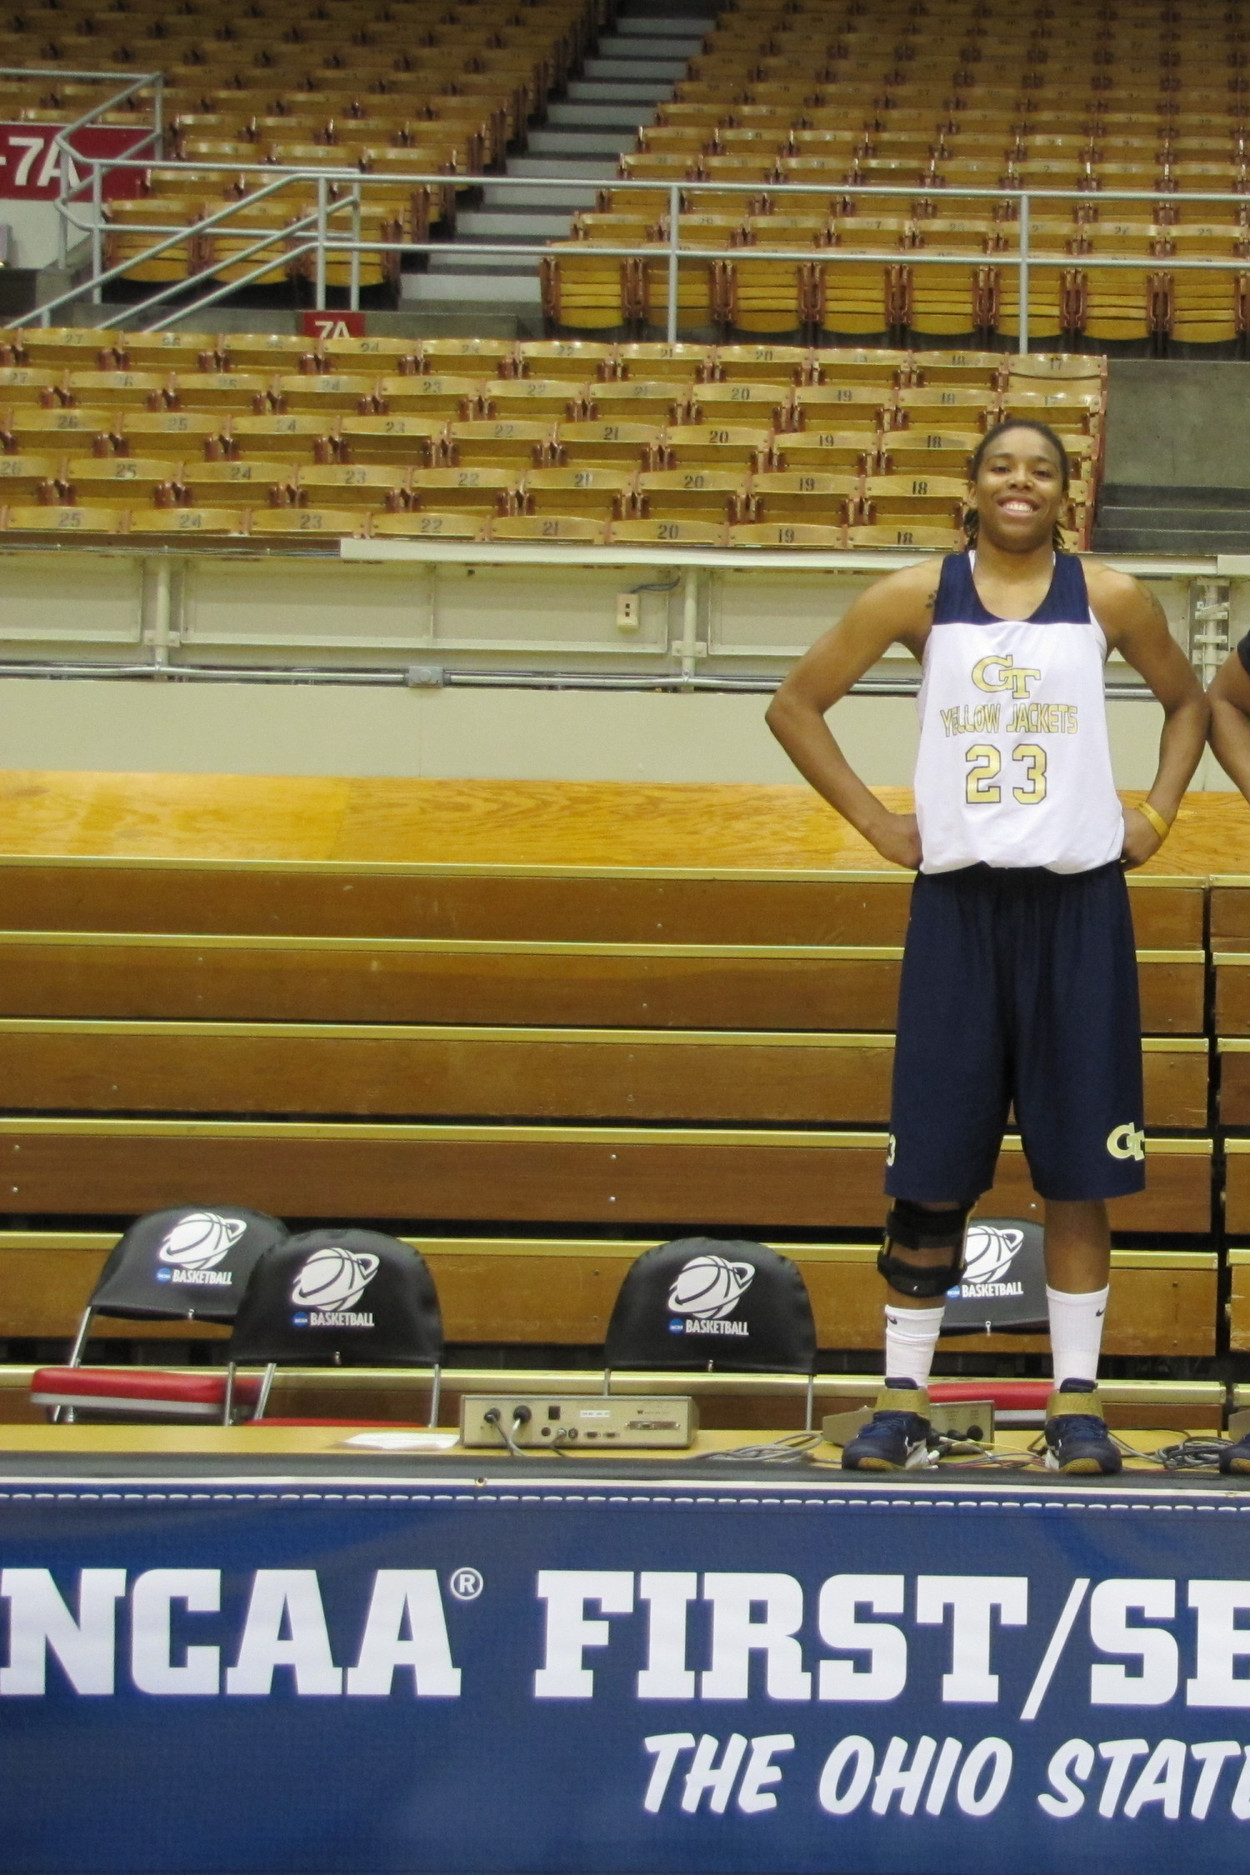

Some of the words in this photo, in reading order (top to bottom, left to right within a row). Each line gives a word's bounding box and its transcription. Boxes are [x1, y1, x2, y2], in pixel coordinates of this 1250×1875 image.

[0, 137, 80, 187] 7A
[315, 322, 350, 338] 7A
[424, 381, 442, 394] 23
[732, 388, 750, 399] 20
[836, 390, 852, 402] 19
[604, 427, 619, 440] 21
[709, 431, 729, 444] 20
[819, 434, 834, 446] 19
[927, 435, 942, 448] 18
[116, 464, 137, 478] 25
[231, 467, 252, 480] 24
[346, 471, 366, 484] 23
[459, 473, 480, 486] 22
[575, 473, 591, 487] 21
[684, 475, 704, 488] 20
[800, 478, 815, 491] 19
[912, 482, 928, 495] 18
[59, 513, 81, 527] 25
[179, 514, 201, 528] 24
[301, 514, 322, 529] 23
[421, 518, 443, 533] 22
[543, 522, 559, 535] 21
[658, 525, 679, 539] 20
[778, 529, 795, 543] 19
[897, 532, 913, 545] 18
[971, 654, 1041, 699] GT
[939, 703, 1001, 737] YELLOW
[1006, 703, 1078, 735] JACKETS
[965, 743, 1047, 805] 23
[172, 1269, 232, 1285] BASKETBALL
[962, 1282, 1024, 1298] BASKETBALL
[310, 1312, 374, 1327] BASKETBALL
[685, 1320, 749, 1336] BASKETBALL
[643, 1732, 795, 1814] THE
[818, 1735, 1012, 1816] OHIO
